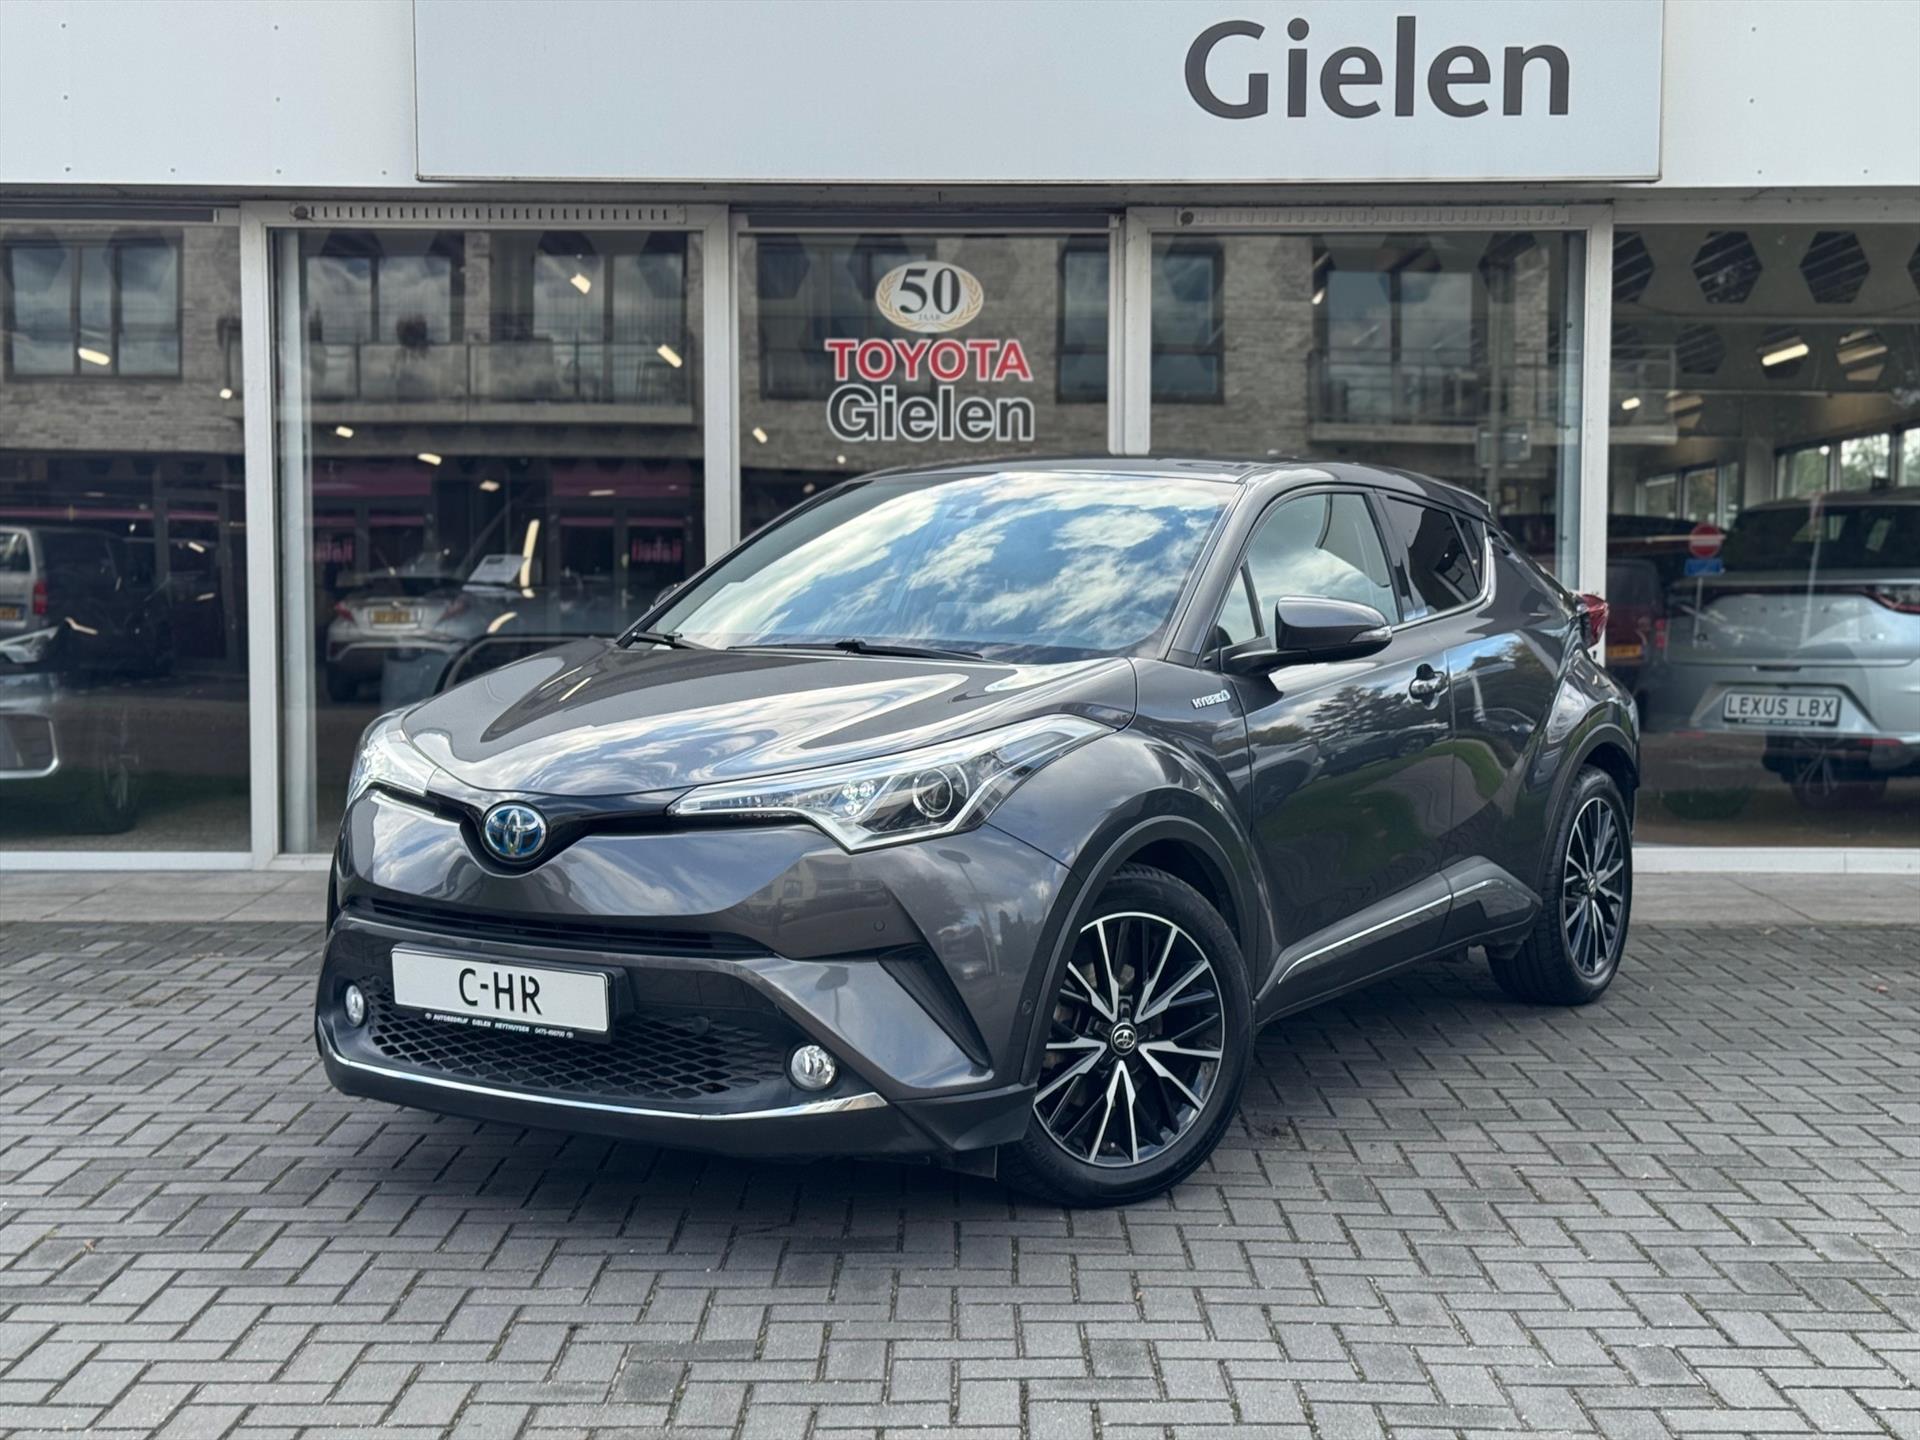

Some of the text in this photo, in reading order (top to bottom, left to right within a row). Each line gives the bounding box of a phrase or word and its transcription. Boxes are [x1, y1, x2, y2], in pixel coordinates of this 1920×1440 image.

[1184, 15, 1570, 119] Gielen
[899, 268, 961, 314] 50
[825, 339, 1033, 381] TOYOTA
[827, 384, 1035, 442] Gielen
[1727, 696, 1834, 718] LEXUS LBX
[459, 968, 542, 1015] C-HR
